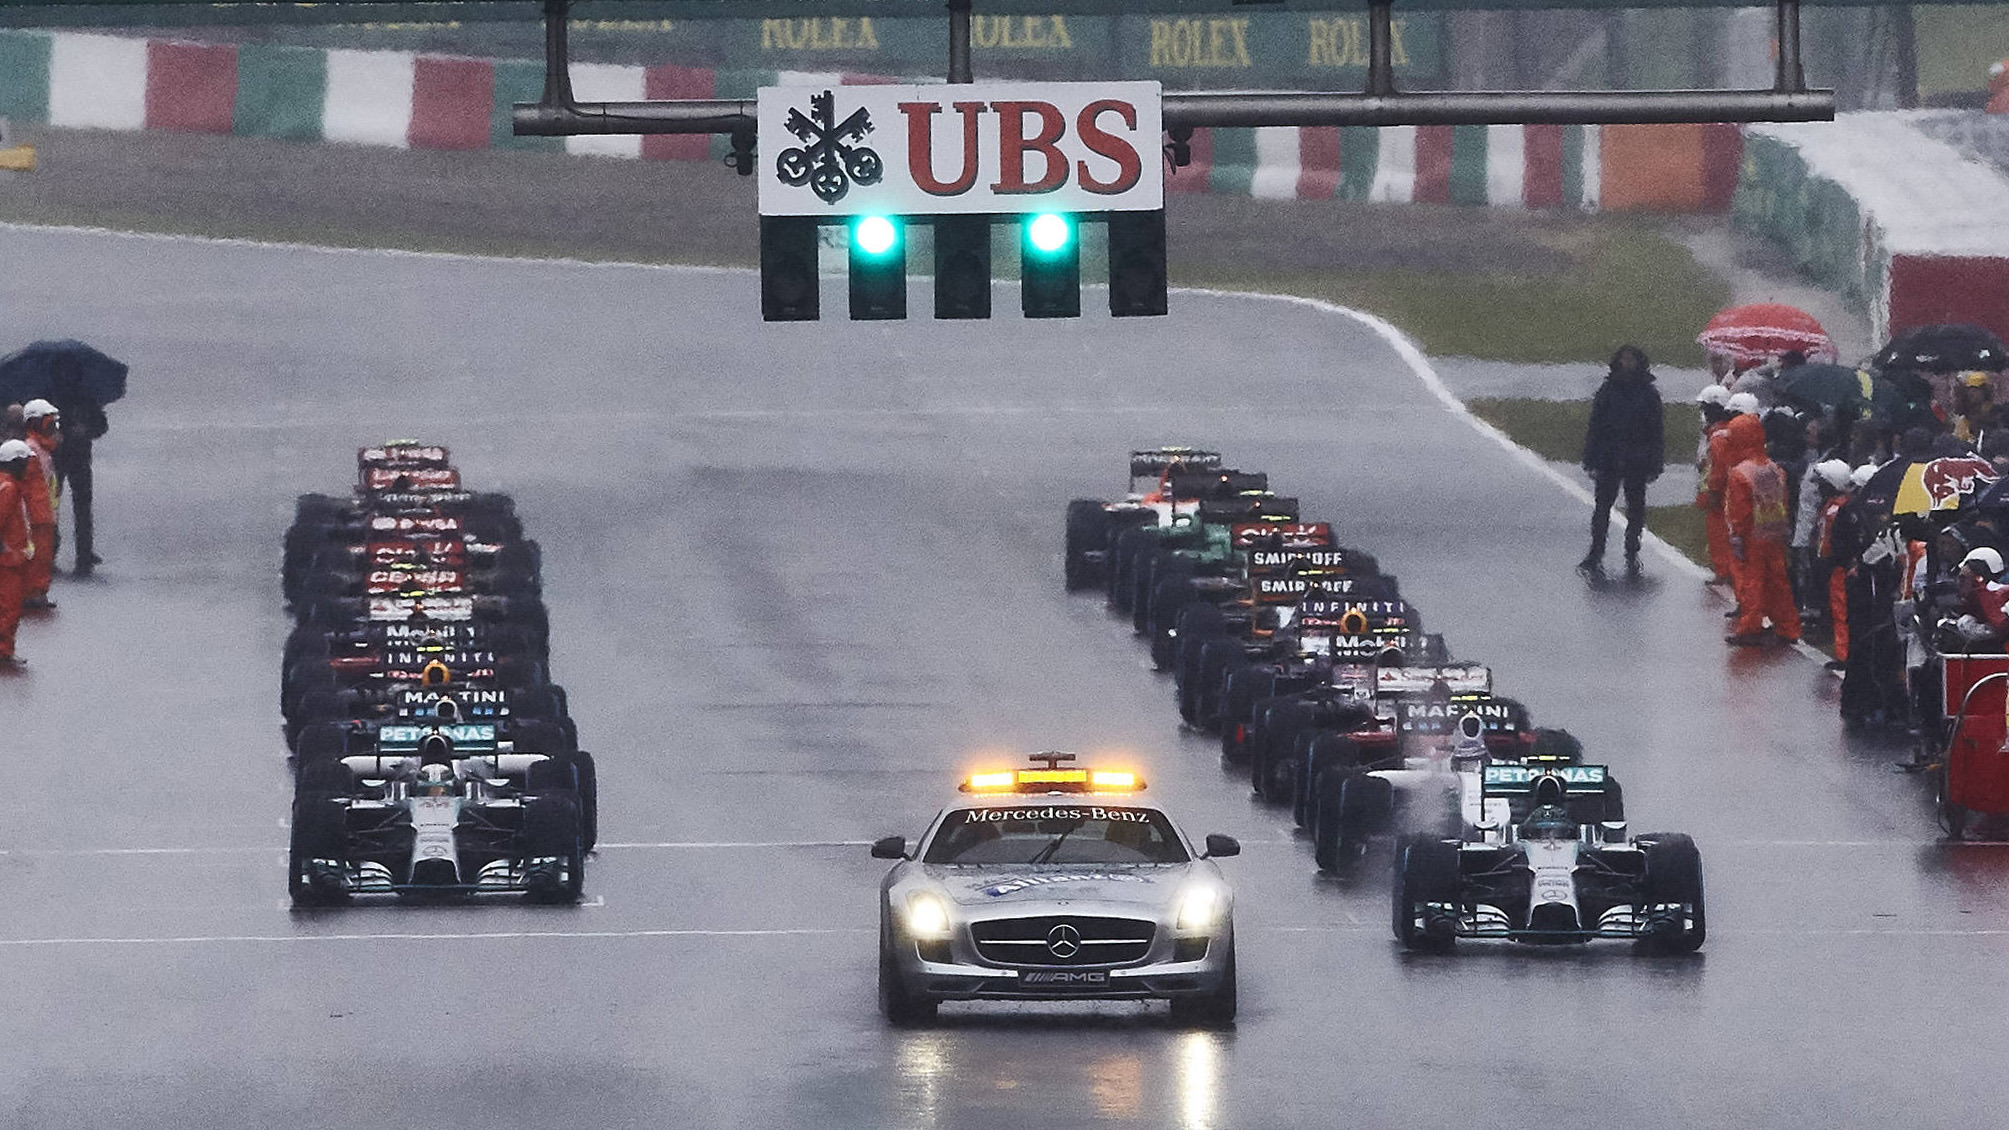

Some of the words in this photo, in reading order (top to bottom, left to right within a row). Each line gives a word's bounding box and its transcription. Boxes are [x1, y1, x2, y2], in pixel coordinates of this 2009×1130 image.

[968, 15, 1074, 48] OLEX
[1151, 19, 1250, 67] ROLEX
[1309, 19, 1407, 66] ROLX
[897, 99, 1143, 197] UBS
[1254, 552, 1342, 564] SMIROFF
[1261, 581, 1353, 592] SMIROFF
[1302, 602, 1404, 613] INFINITI
[387, 625, 455, 646] Moil
[387, 652, 494, 664] INFNITI
[405, 691, 505, 703] MATINI
[1408, 705, 1509, 718] MARINI
[1485, 767, 1604, 782] PETRNAS
[965, 807, 1150, 823] Mercedes-Benz
[1050, 972, 1106, 982] AMG
